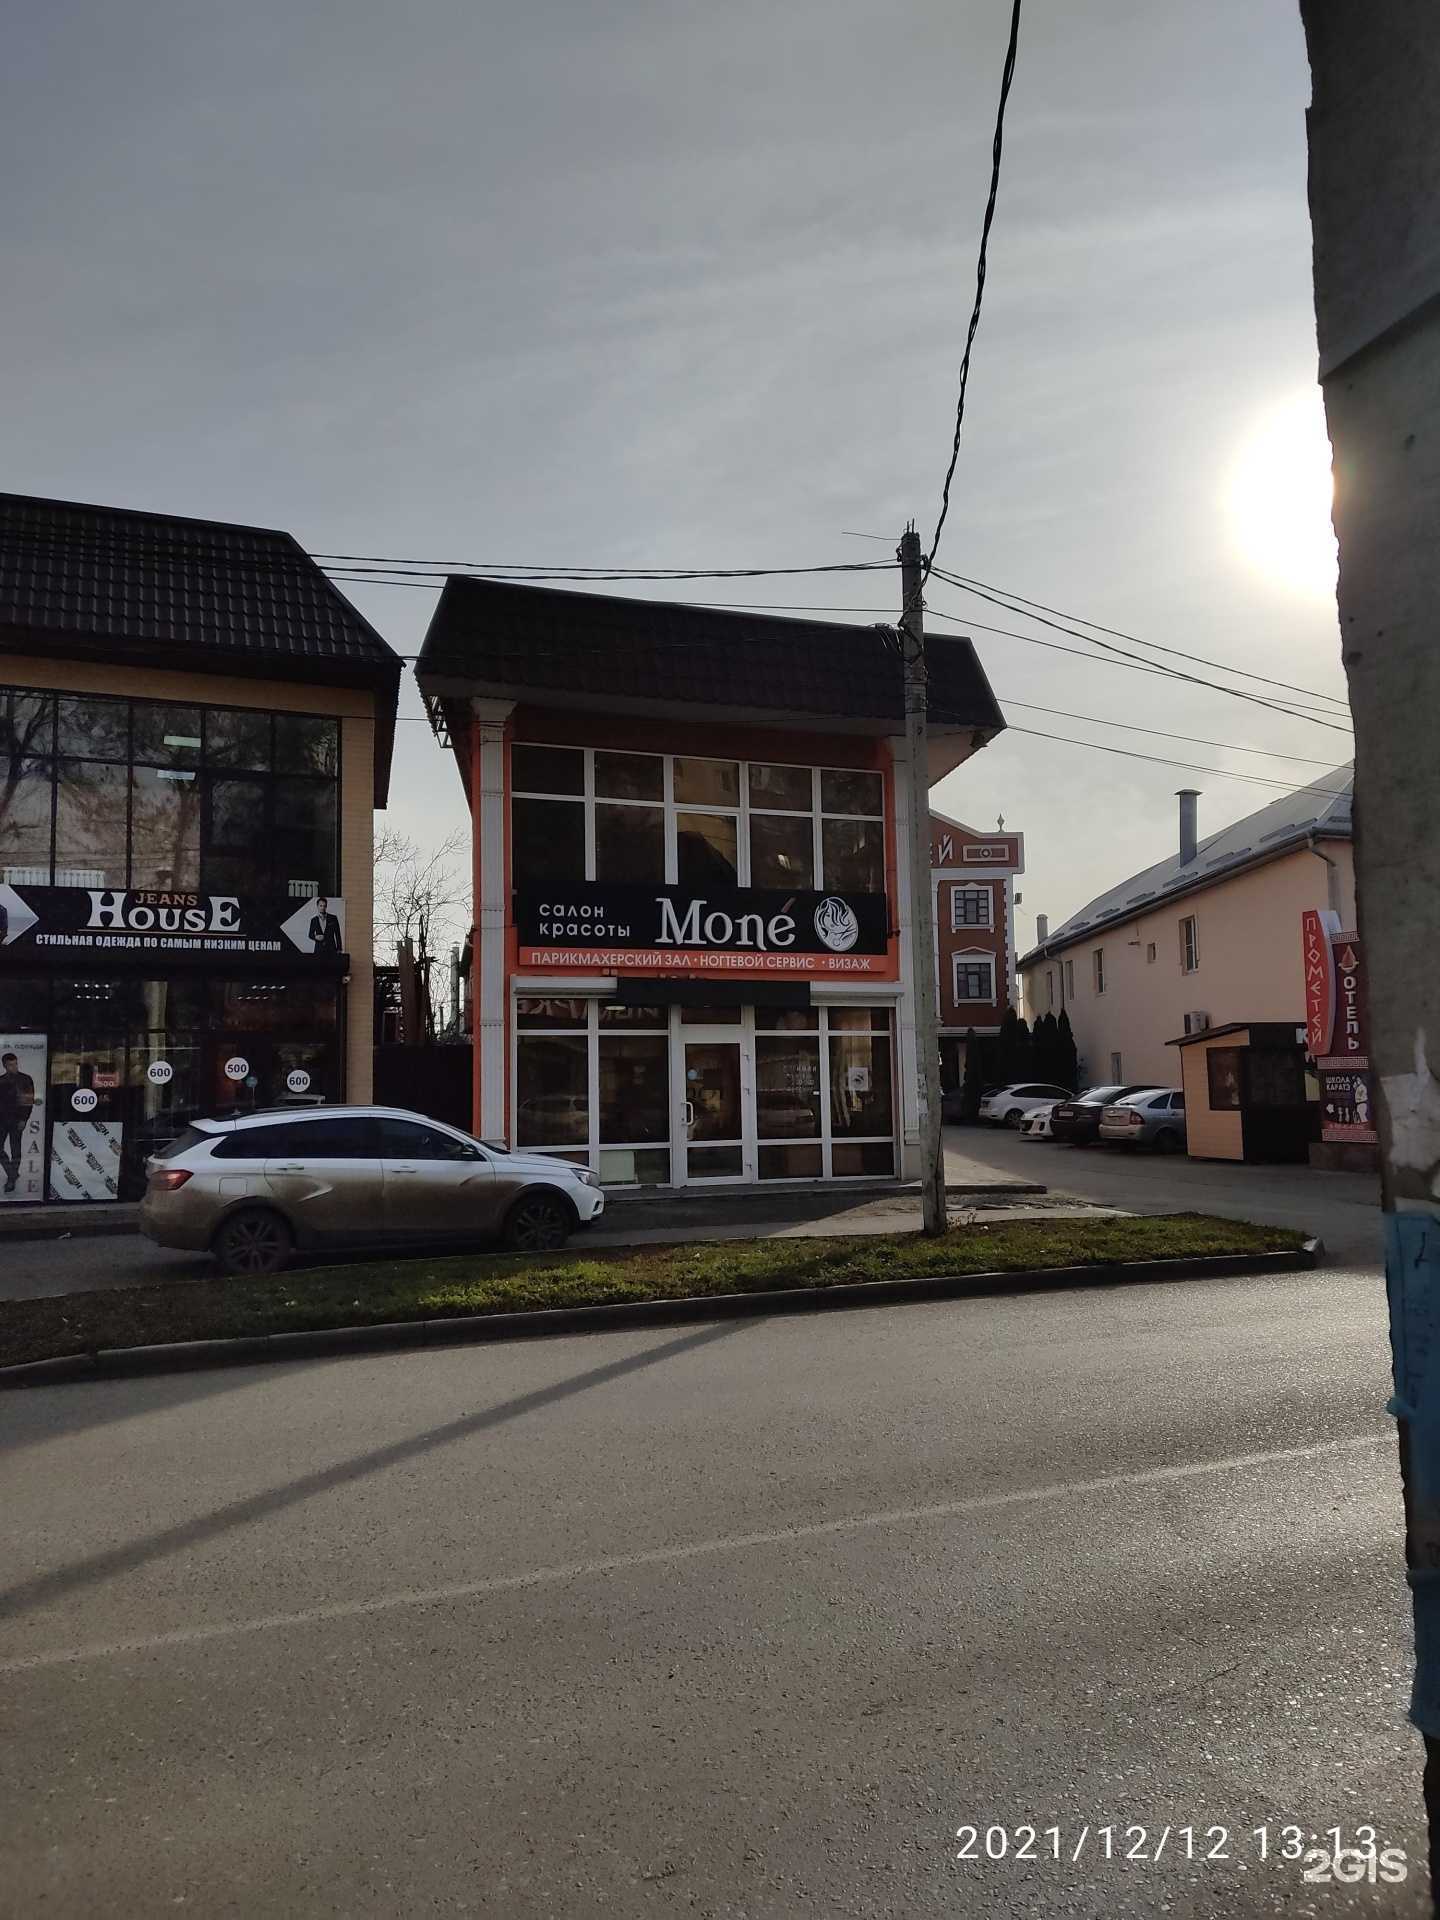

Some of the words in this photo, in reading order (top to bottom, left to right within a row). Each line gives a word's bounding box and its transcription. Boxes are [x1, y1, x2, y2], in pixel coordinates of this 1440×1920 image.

[135, 892, 198, 907] JEANS
[538, 903, 604, 918] салон
[538, 922, 631, 939] красоты
[36, 933, 93, 946] СТИЛЬНАЯ
[95, 935, 141, 949] ОДЕЖДА
[143, 937, 157, 948] ПО
[160, 937, 202, 949] САМЫМ
[204, 939, 246, 950] НИЗКИМ
[248, 941, 282, 952] ЦЕНАМ
[531, 952, 662, 967] ПАРИКМАХЕРСКИЙ
[664, 954, 691, 967] ЗАЛ
[699, 954, 764, 969] НОГТЕВОЙ
[766, 957, 815, 970] СЕРВИС
[828, 958, 871, 970] ВИЗАЖ
[1305, 917, 1324, 1045] ПРОМЕТЕЙ
[1343, 976, 1360, 1050] ОТЕЛЬ
[150, 1068, 170, 1077] 600
[227, 1064, 247, 1073] 500
[289, 1077, 308, 1085] 600
[73, 1095, 95, 1105] 600
[28, 1120, 40, 1193] SALE
